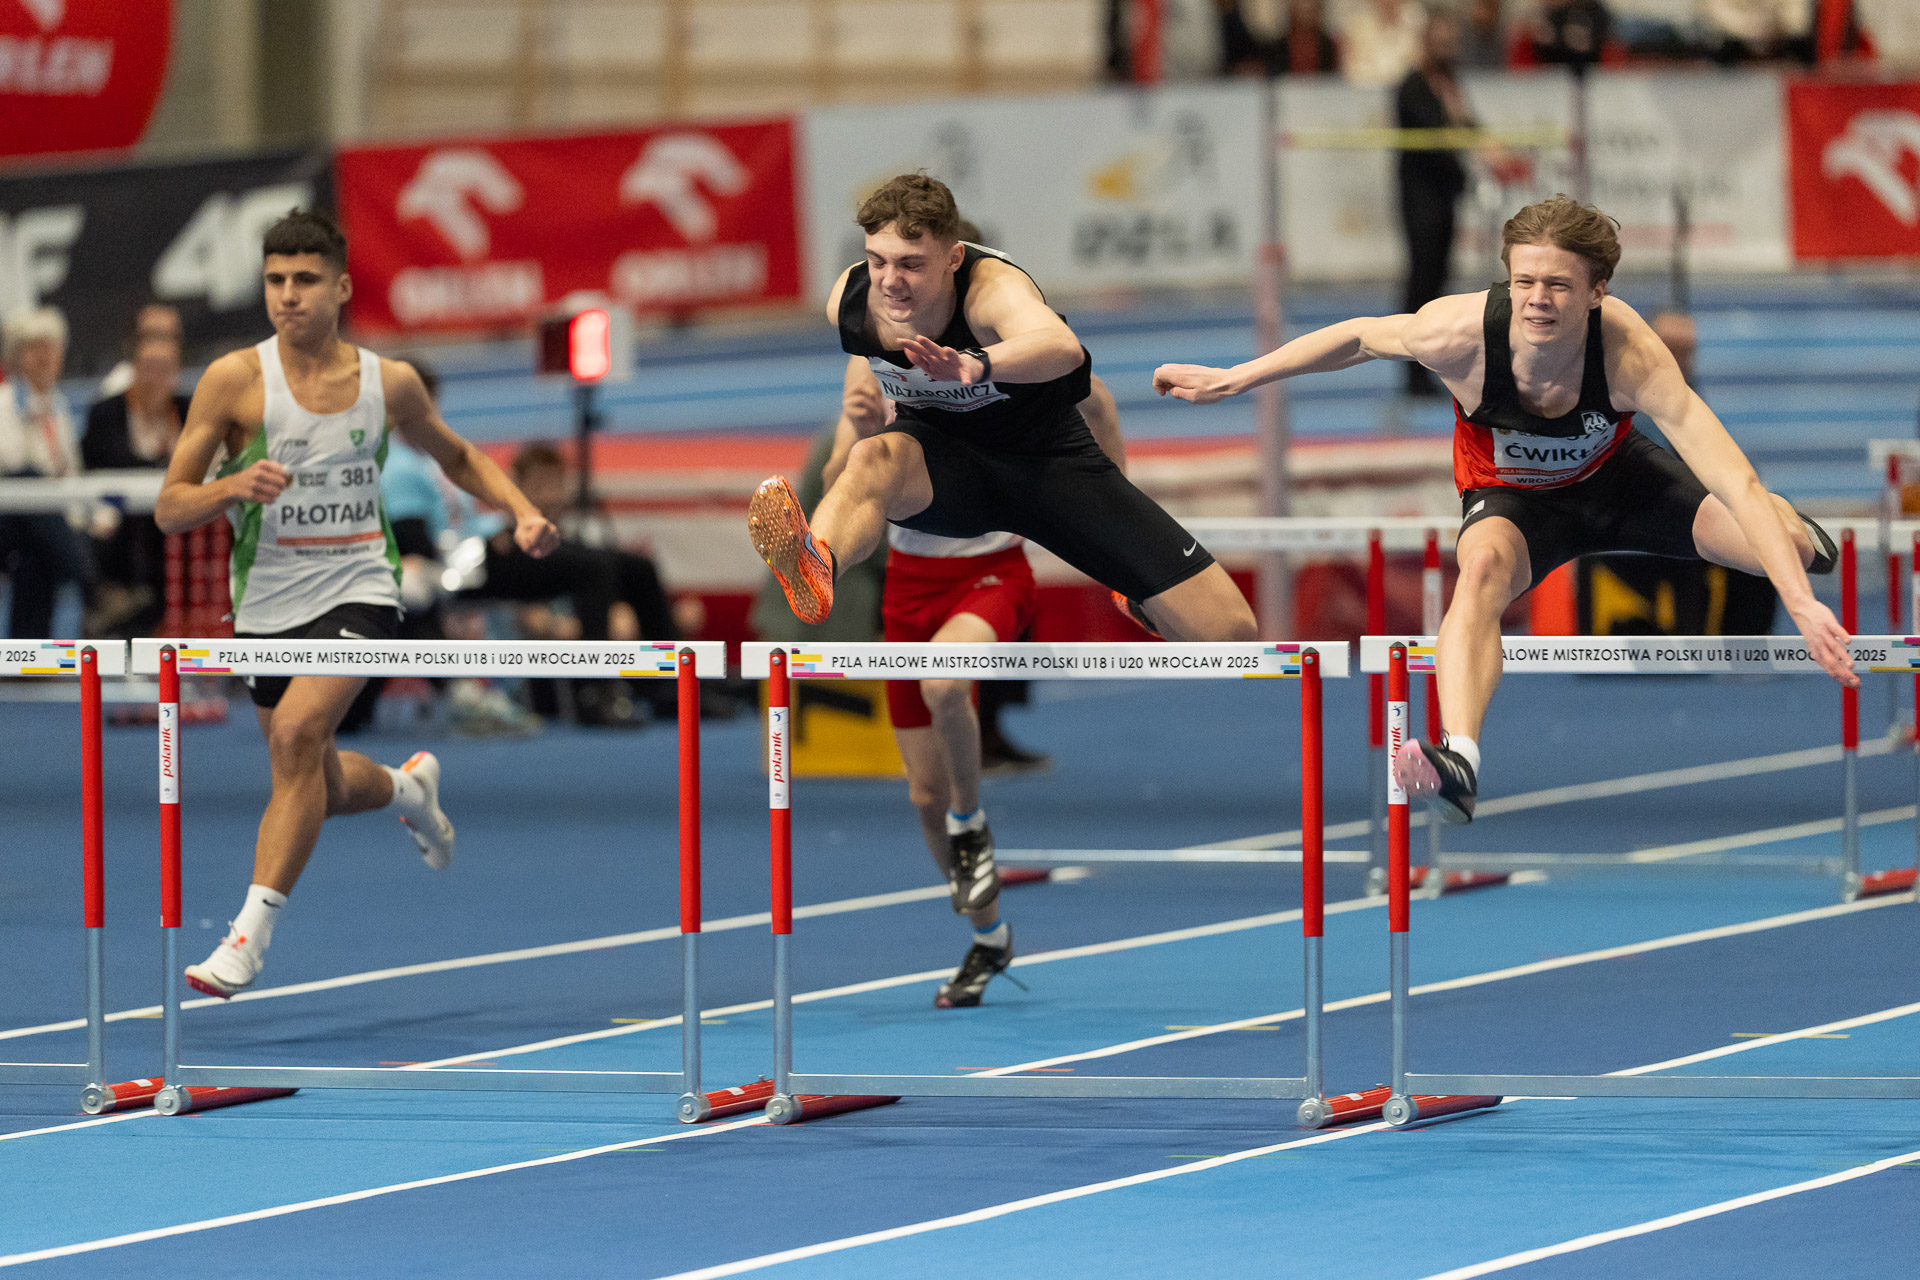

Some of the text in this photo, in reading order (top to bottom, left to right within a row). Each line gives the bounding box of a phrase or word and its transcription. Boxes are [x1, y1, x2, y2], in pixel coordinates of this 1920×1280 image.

[881, 380, 991, 400] NAZAROWICZ
[341, 466, 374, 487] 381
[281, 499, 376, 525] PŁOTAŁA
[6, 651, 36, 662] 2025
[219, 652, 635, 664] PZLA HALOWE MISTRZOSTWA POLSKI U18 i U20 WROCŁAW 2025
[832, 656, 1259, 668] PZLA HALOWE MISTRZOSTWA POLSKI U18 i U20 WROCŁAW 2025
[1553, 649, 1651, 661] MISTRZOSTWA
[1656, 649, 1702, 661] POLSKI
[1707, 649, 1732, 661] U18
[1736, 649, 1740, 661] i
[1744, 649, 1769, 661] U20
[1854, 649, 1887, 661] 2025
[161, 727, 174, 778] polanik
[772, 731, 785, 783] polanik
